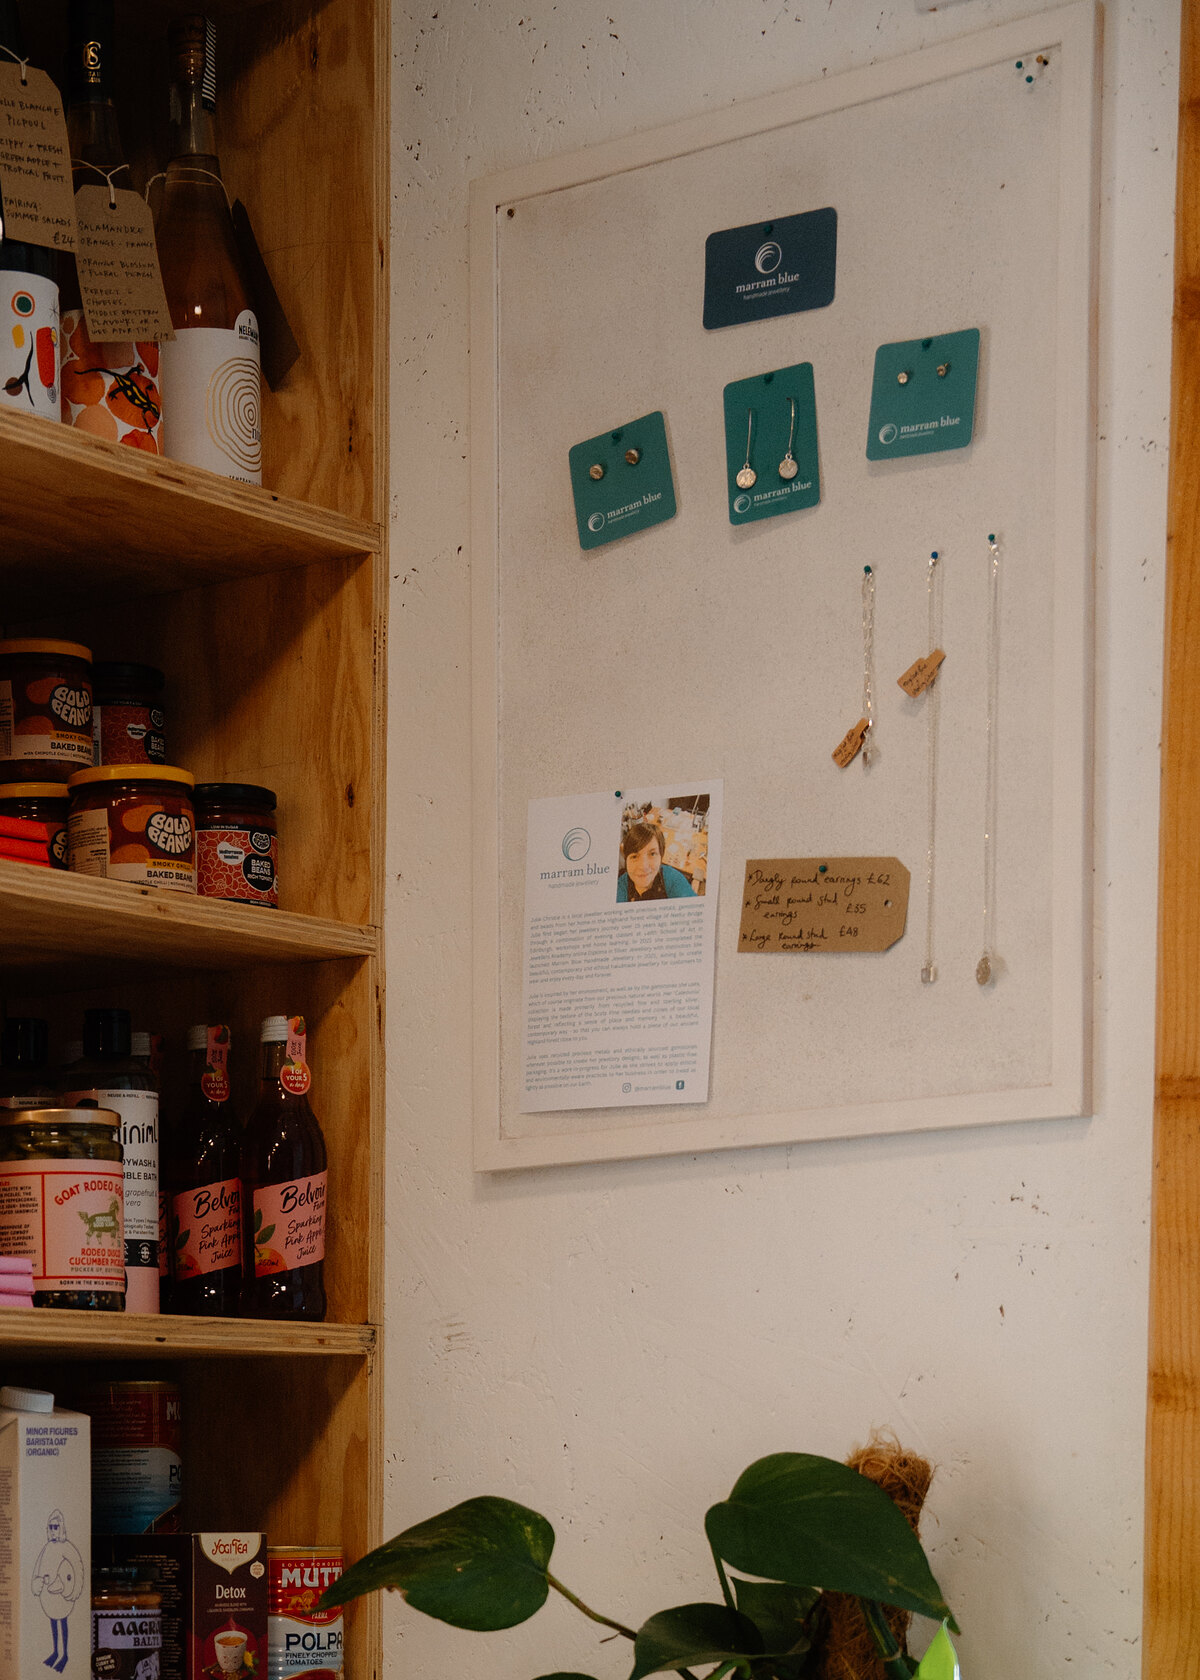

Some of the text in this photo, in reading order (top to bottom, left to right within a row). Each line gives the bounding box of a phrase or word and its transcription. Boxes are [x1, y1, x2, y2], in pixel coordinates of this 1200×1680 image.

[736, 272, 800, 293] marram blue
[900, 415, 960, 434] marram blue
[754, 480, 812, 502] marram blue
[607, 492, 662, 519] marram blue
[54, 685, 90, 708] BOLD
[50, 742, 76, 752] BAKED
[151, 813, 190, 836] BOLD
[251, 859, 271, 868] BAKED
[146, 870, 172, 880] BAKED
[251, 867, 271, 876] BEANS
[540, 863, 610, 880] marram blue
[867, 872, 890, 886] £62
[846, 902, 867, 914] £35
[840, 924, 859, 938] £48
[54, 1180, 113, 1206] GOAT RODEO
[287, 1214, 322, 1236] Sparkling
[285, 1235, 303, 1250] Pink
[81, 1247, 106, 1257] RODEO
[210, 1249, 234, 1265] Juice
[296, 1245, 316, 1260] Juice
[69, 1257, 109, 1267] CUCUMBER
[49, 1427, 78, 1436] FIGURES
[54, 1437, 67, 1446] OAT
[212, 1538, 248, 1555] YOGI TEA
[216, 1584, 246, 1599] Detox
[285, 1631, 342, 1651] POLPA
